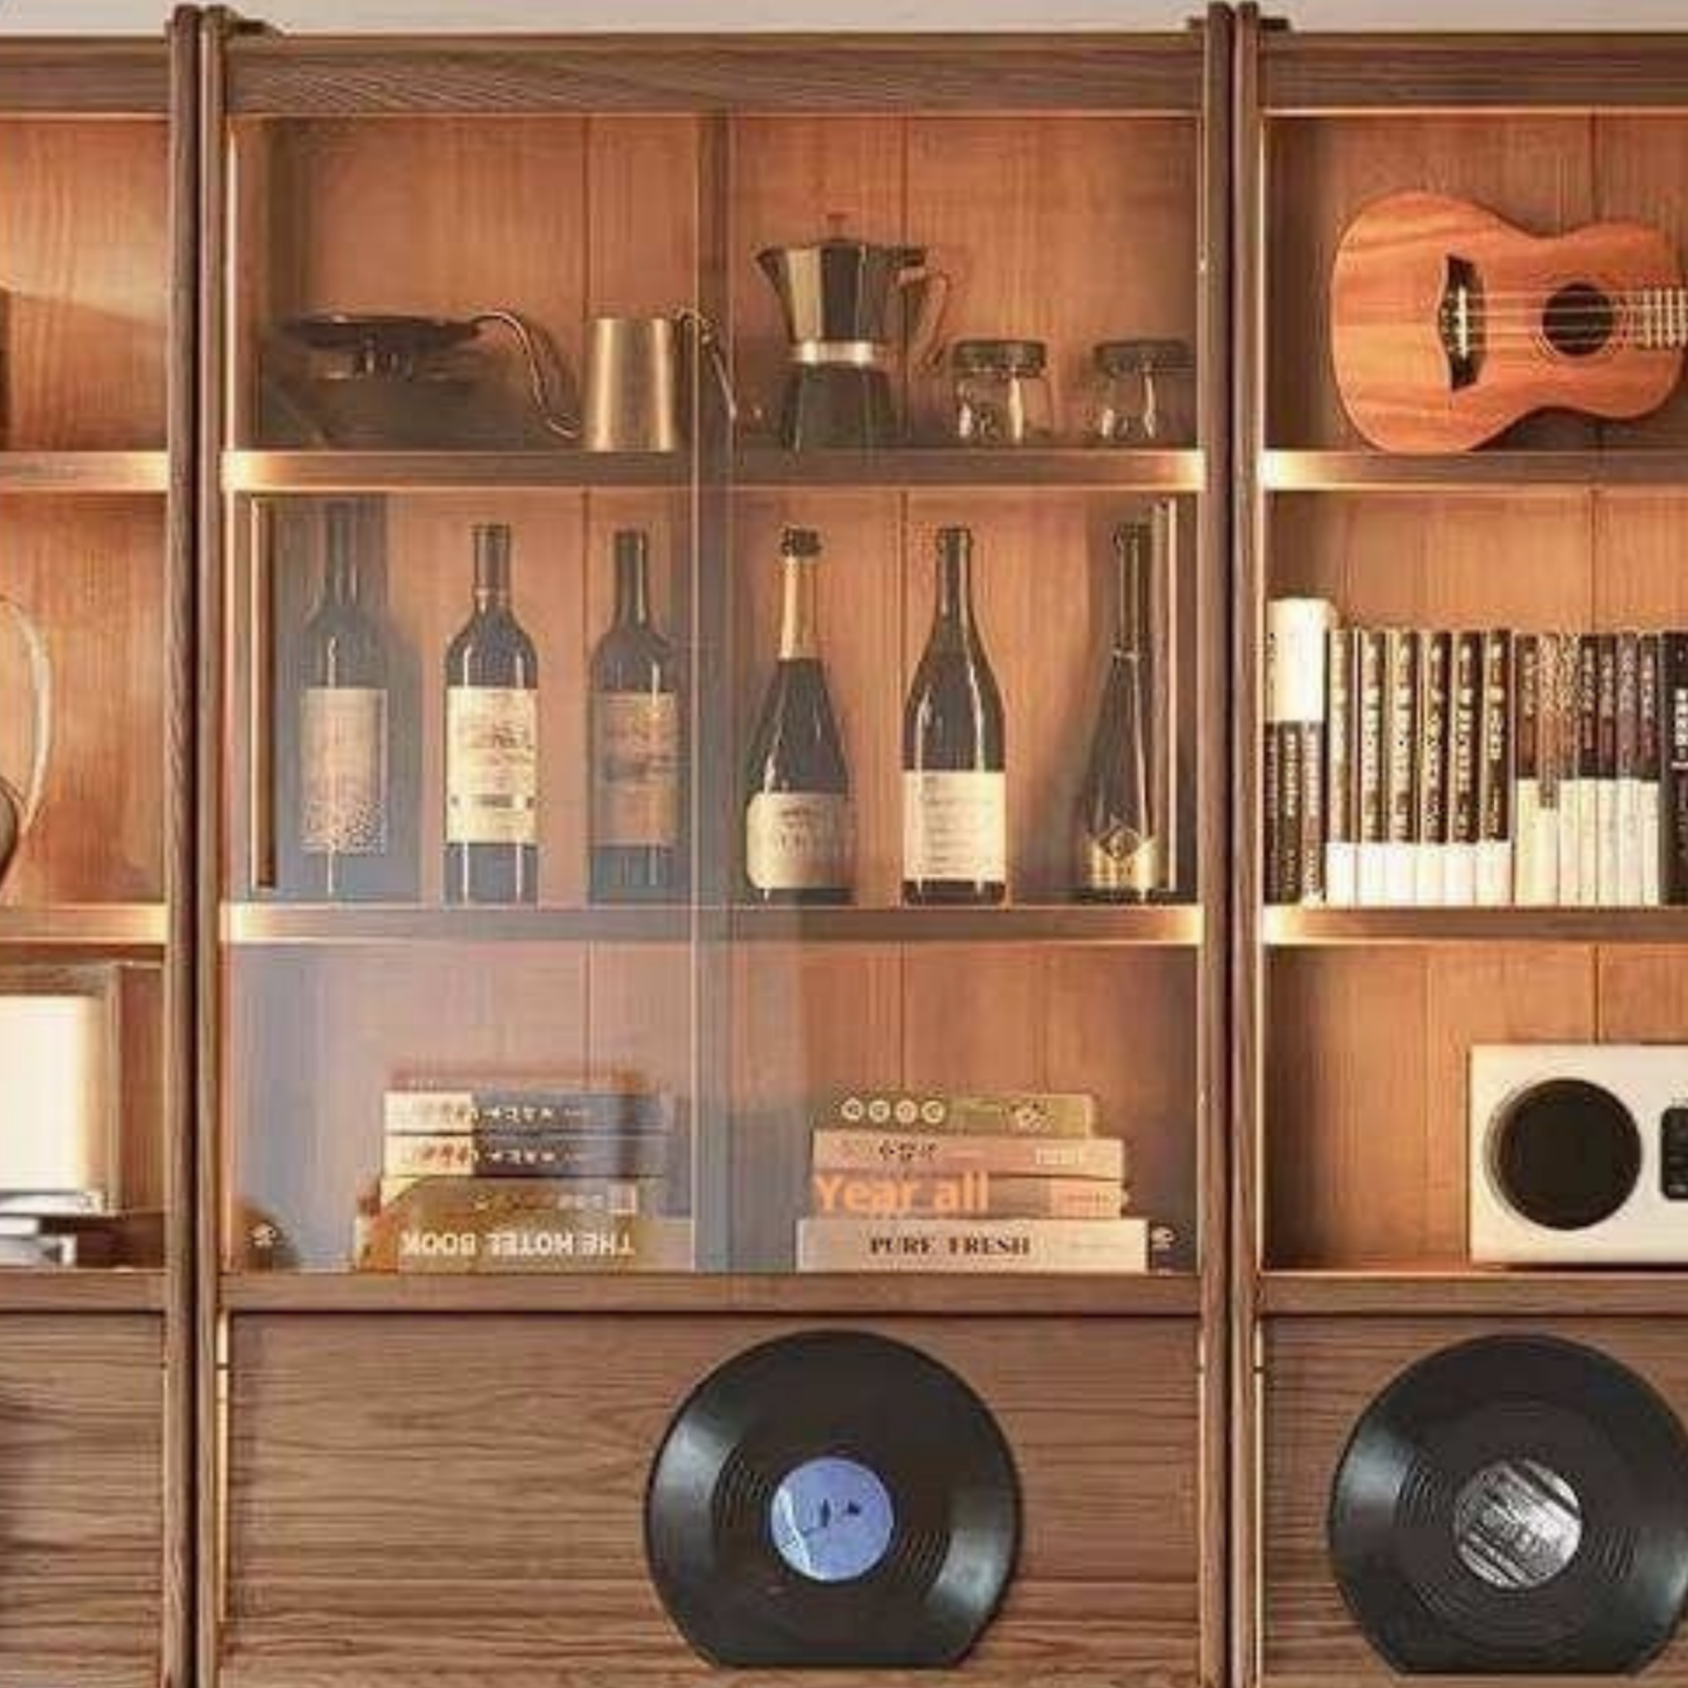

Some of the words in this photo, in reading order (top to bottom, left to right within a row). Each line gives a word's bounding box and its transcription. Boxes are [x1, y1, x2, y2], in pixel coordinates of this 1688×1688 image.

[400, 1230, 477, 1257] BOOK
[489, 1230, 575, 1257] HOTEL
[580, 1230, 637, 1257] THE
[868, 1235, 938, 1256] PURE
[947, 1235, 1032, 1256] FRESH
